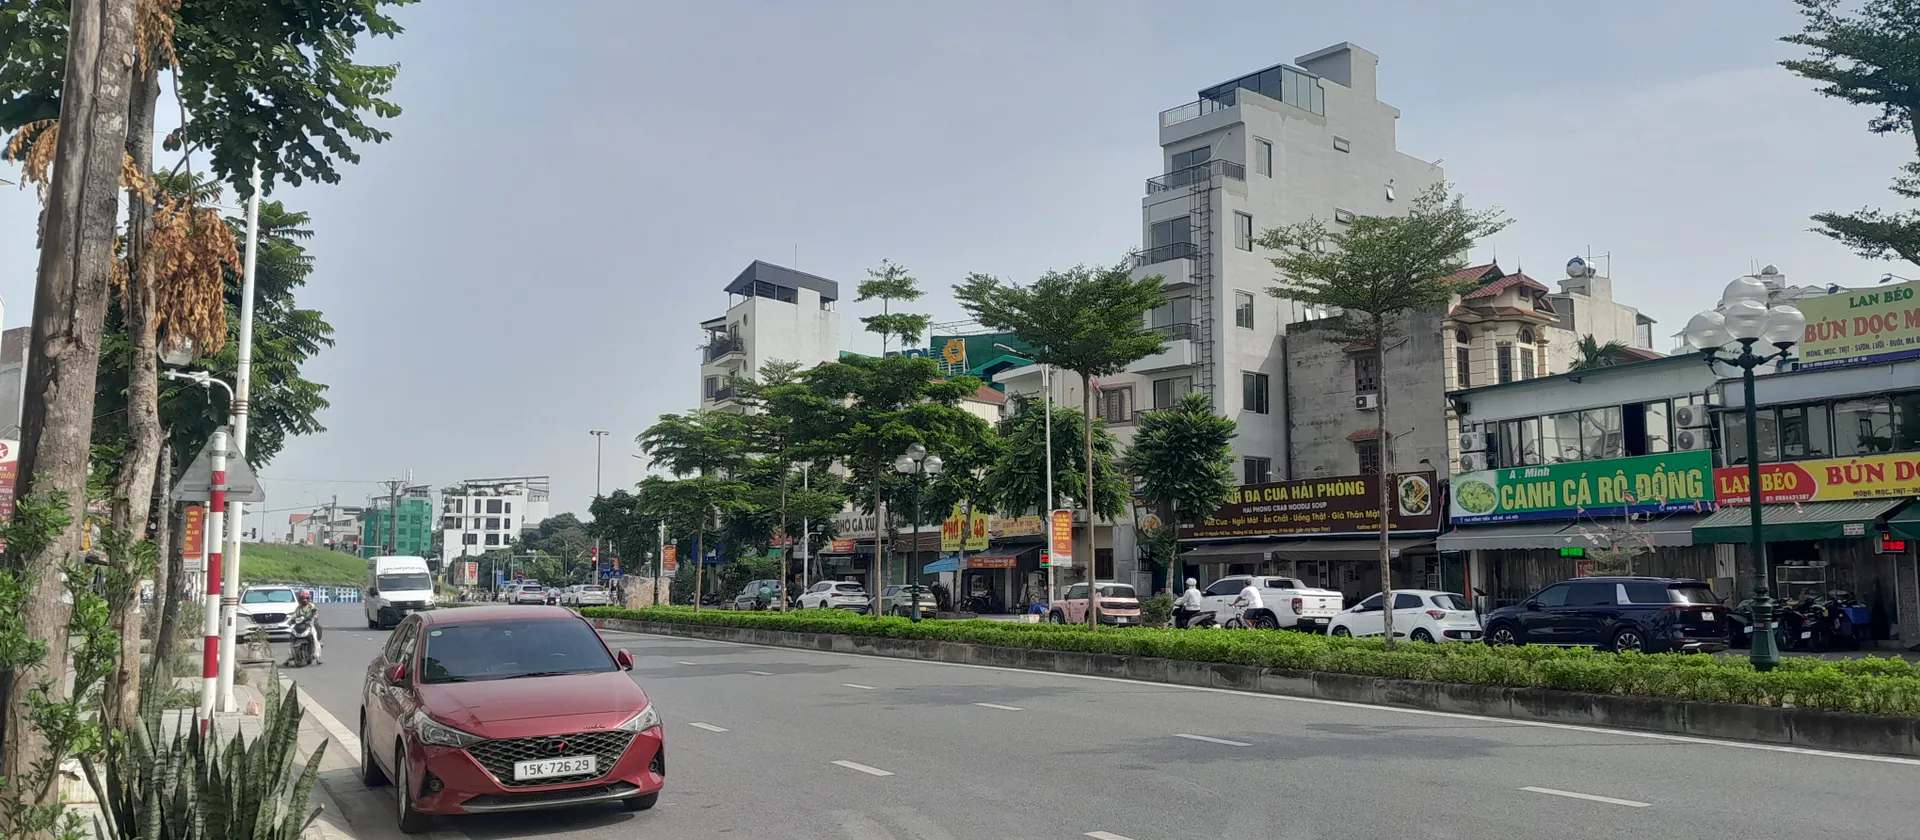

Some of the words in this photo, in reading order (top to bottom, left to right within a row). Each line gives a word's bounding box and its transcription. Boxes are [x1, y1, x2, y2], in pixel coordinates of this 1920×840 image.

[1849, 293, 1879, 308] LAN
[1883, 286, 1914, 303] BÉO
[1804, 316, 1847, 343] BÚN
[1853, 311, 1898, 339] DỌC
[1508, 469, 1516, 479] A
[1524, 466, 1550, 478] Minh
[1760, 467, 1798, 492] BÉO
[1825, 459, 1885, 486] BÚN
[1893, 460, 1920, 482] D
[1244, 489, 1261, 503] ĐA
[1263, 487, 1289, 502] CUA
[1291, 480, 1314, 500] HẢI
[1316, 479, 1366, 498] PHÒNG
[1500, 480, 1556, 510] CANH
[1563, 472, 1592, 506] CÁ
[1597, 469, 1628, 503] RÔ
[1634, 461, 1704, 502] ĐỒNG
[1215, 518, 1228, 526] Cua
[1293, 512, 1310, 523] Uống
[1331, 510, 1345, 520] Giá
[1345, 510, 1364, 519] Thân
[1252, 505, 1272, 513] PHONG
[1288, 503, 1311, 511] NOODLE
[1311, 501, 1328, 509] SOUP
[943, 515, 959, 540] PHỞ
[522, 759, 589, 776] 15K-726.29
